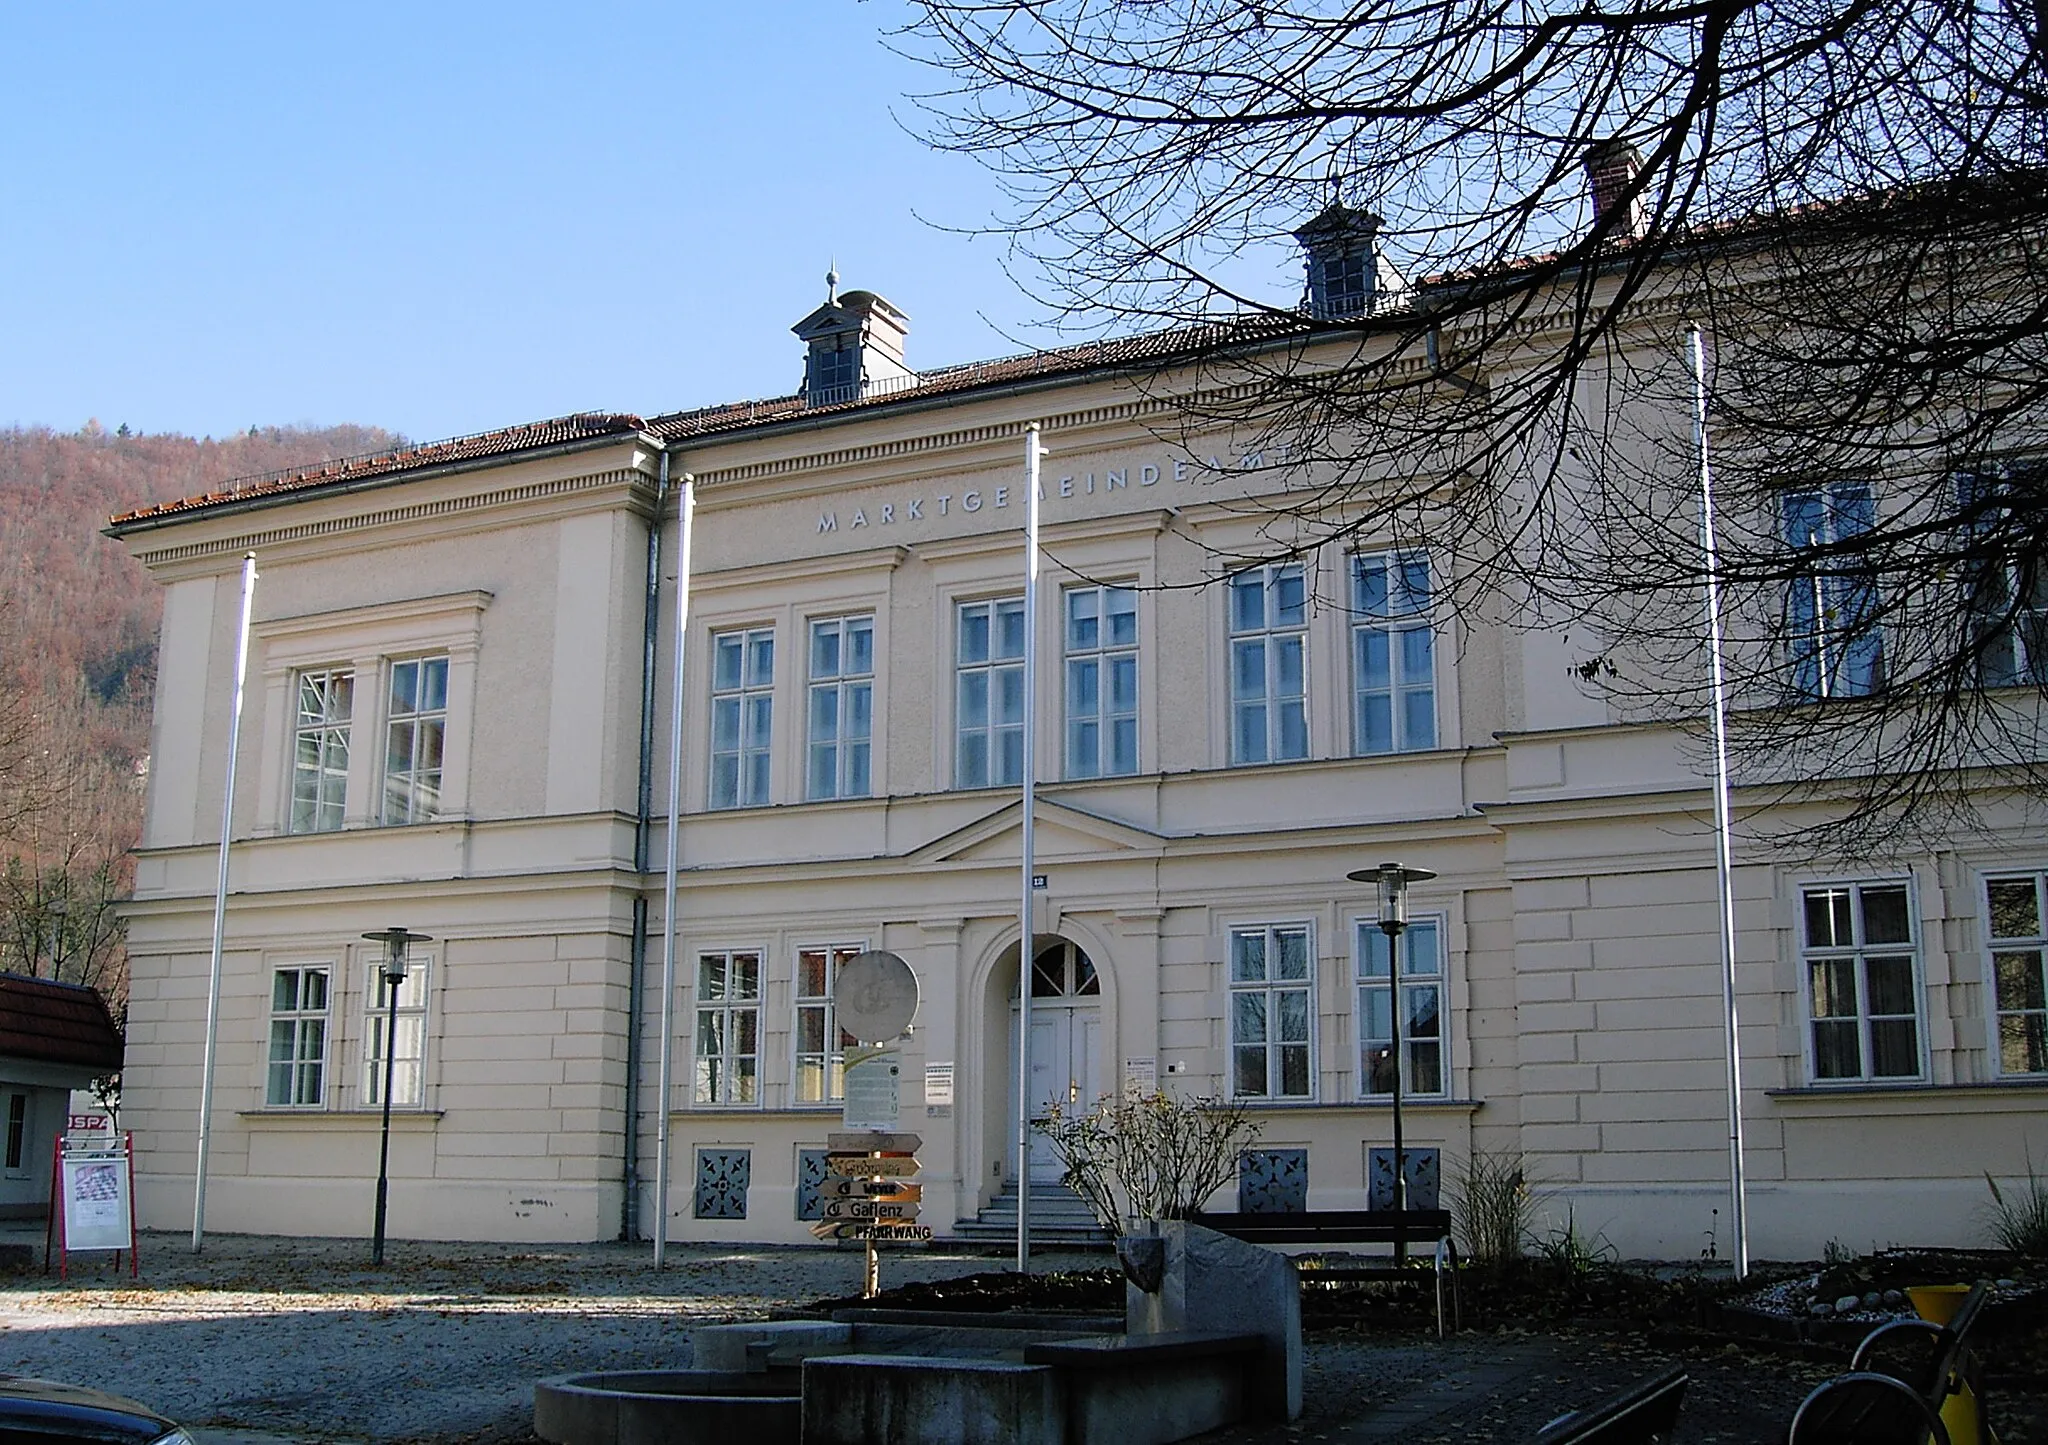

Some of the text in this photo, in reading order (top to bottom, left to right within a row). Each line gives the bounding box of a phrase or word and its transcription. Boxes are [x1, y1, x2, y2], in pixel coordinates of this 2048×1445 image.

[816, 444, 1293, 534] MARKTGEEINDEAMT
[850, 1202, 903, 1217] Gaflenz
[855, 1225, 932, 1239] PFARRWANG
